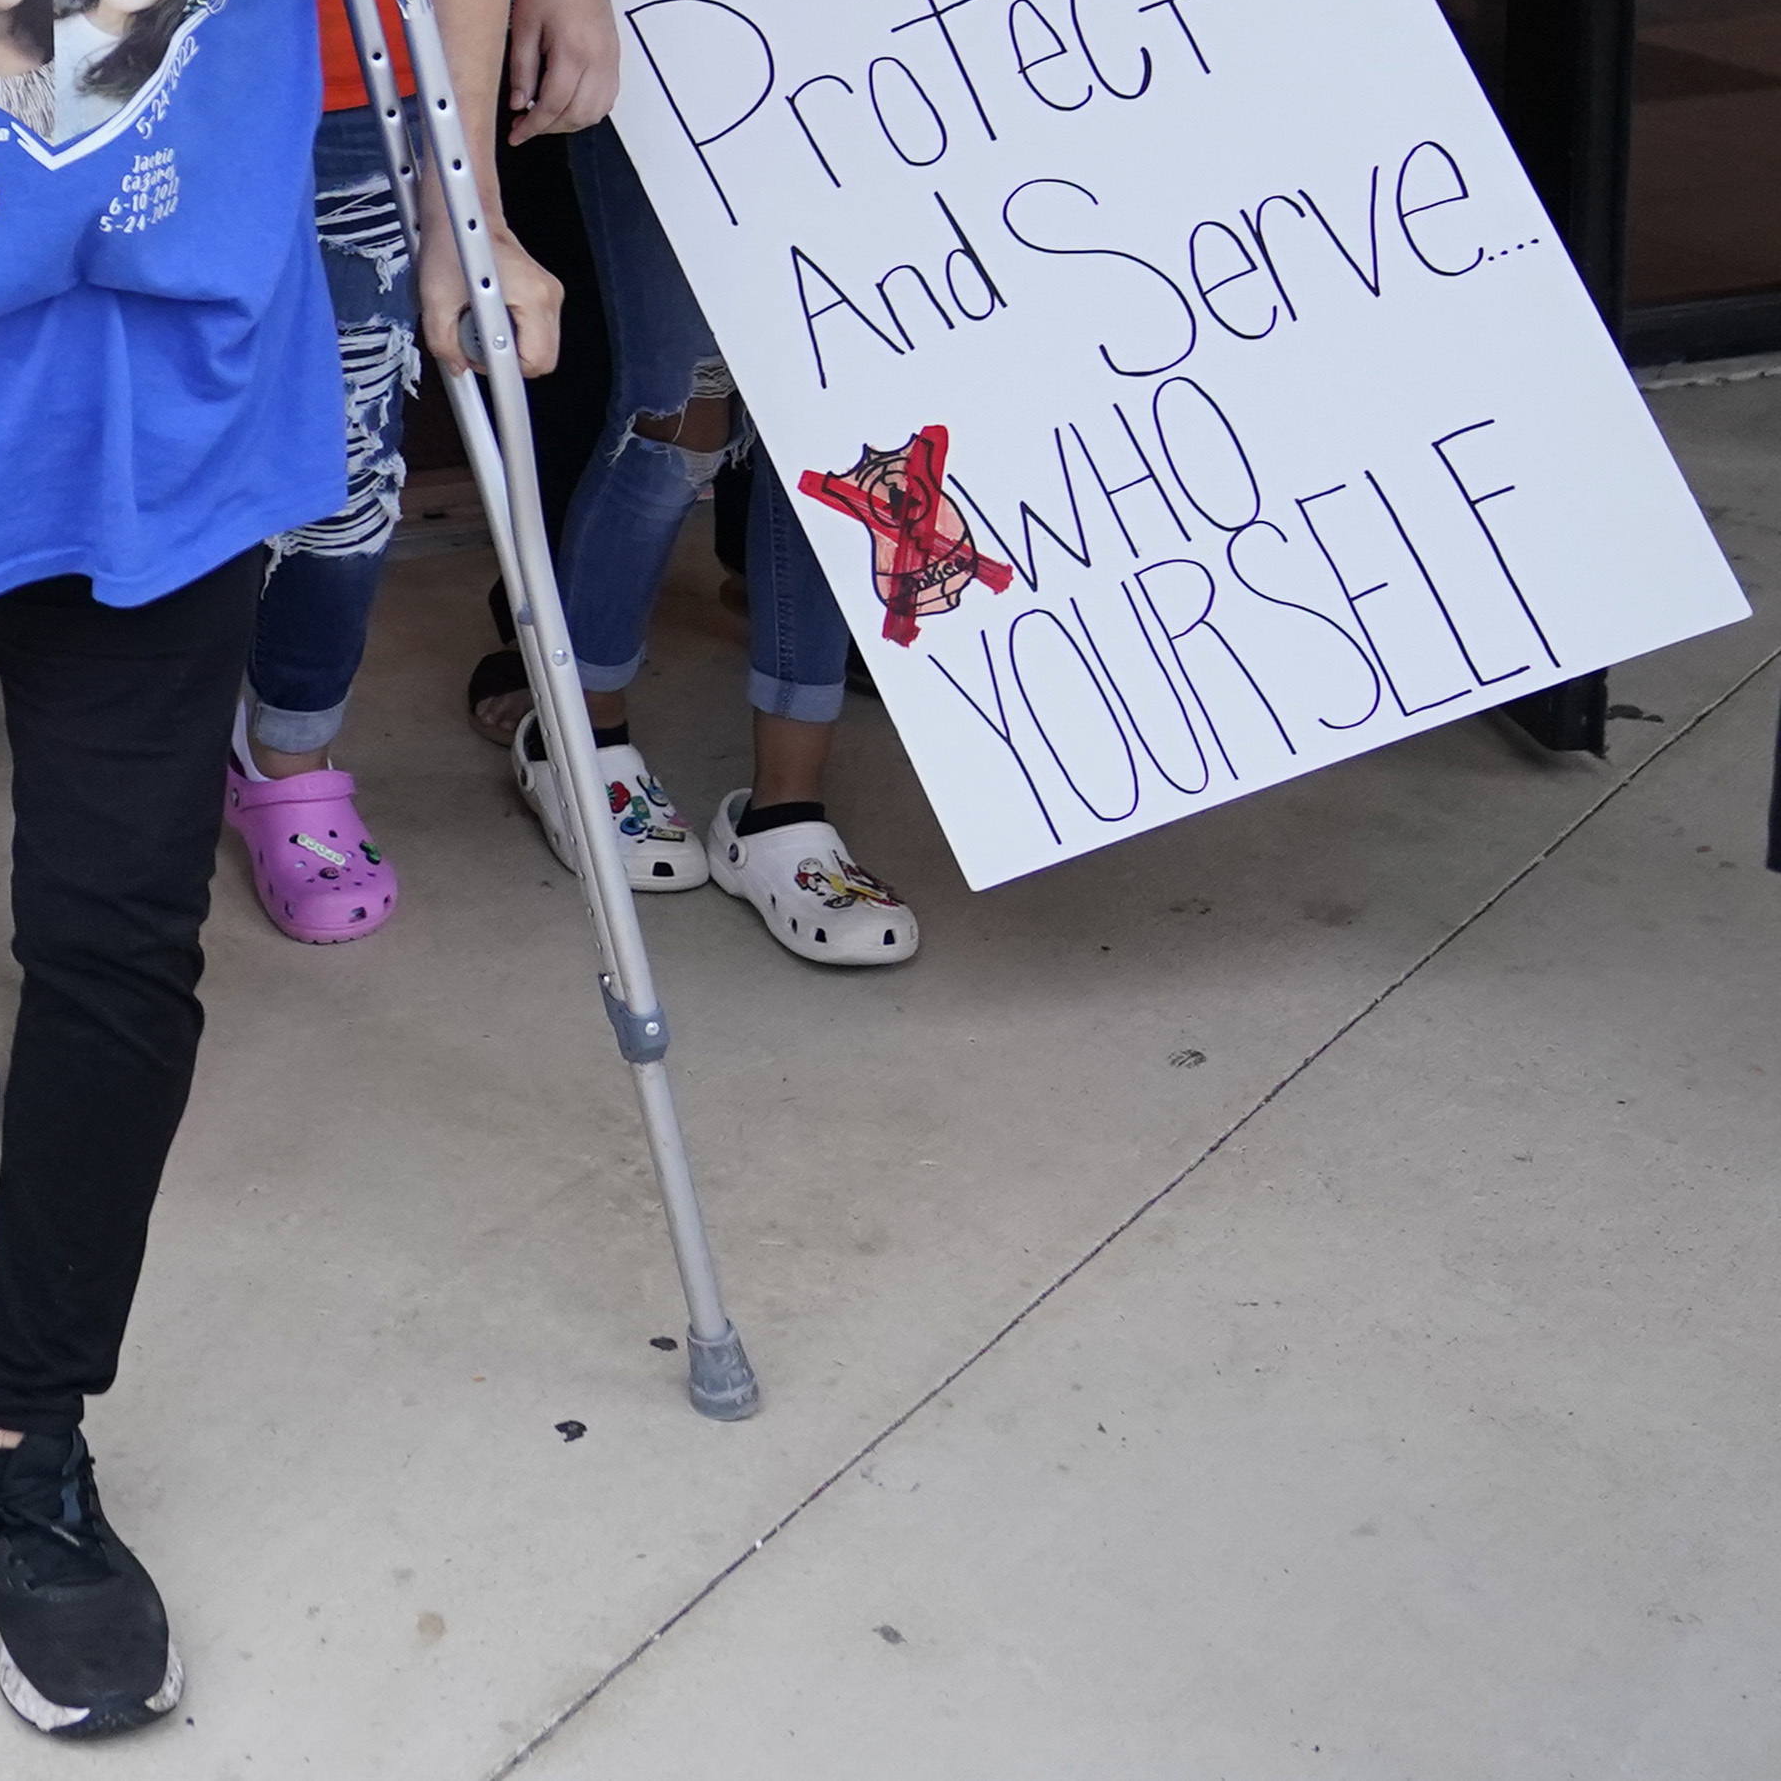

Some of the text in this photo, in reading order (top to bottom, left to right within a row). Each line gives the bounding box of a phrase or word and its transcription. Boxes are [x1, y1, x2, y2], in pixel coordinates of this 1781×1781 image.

[791, 191, 1009, 391] And
[947, 375, 1262, 594] WHO
[927, 419, 1561, 846] YOURSELF
